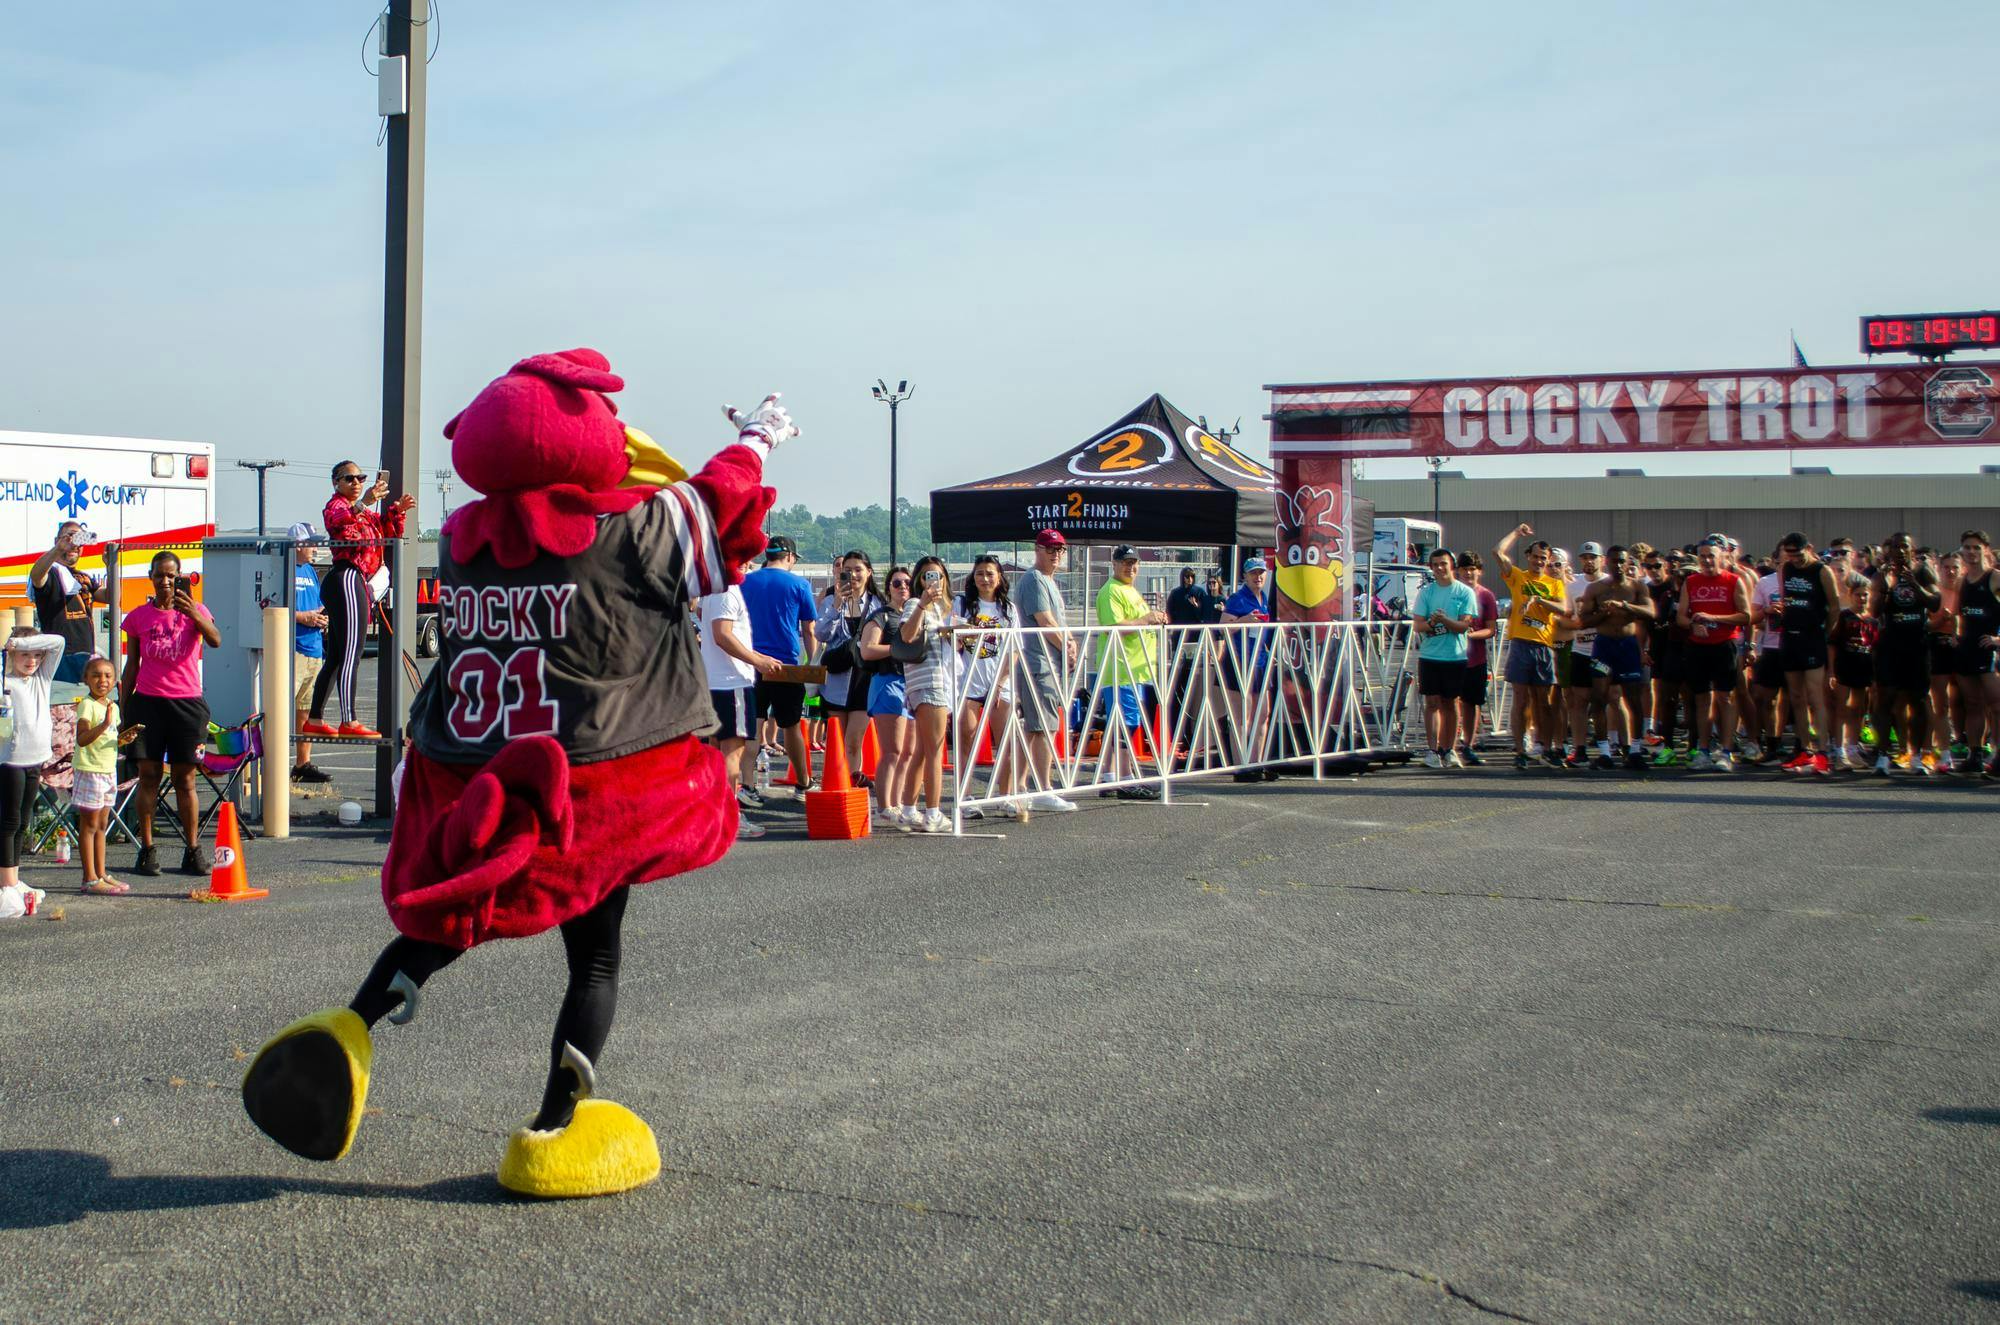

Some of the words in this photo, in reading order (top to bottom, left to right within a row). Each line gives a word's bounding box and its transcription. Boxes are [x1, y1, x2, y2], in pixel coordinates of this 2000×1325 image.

[1868, 316, 1995, 346] 09:19:49
[1443, 379, 1671, 448] COCKY
[1698, 372, 1876, 441] TROT
[1097, 432, 1146, 471] 2
[91, 484, 147, 505] COUNTY
[1032, 521, 1057, 530] EVENT
[1063, 520, 1121, 530] MANAGEMENT
[439, 584, 577, 642] COCKY
[448, 647, 559, 743] 01
